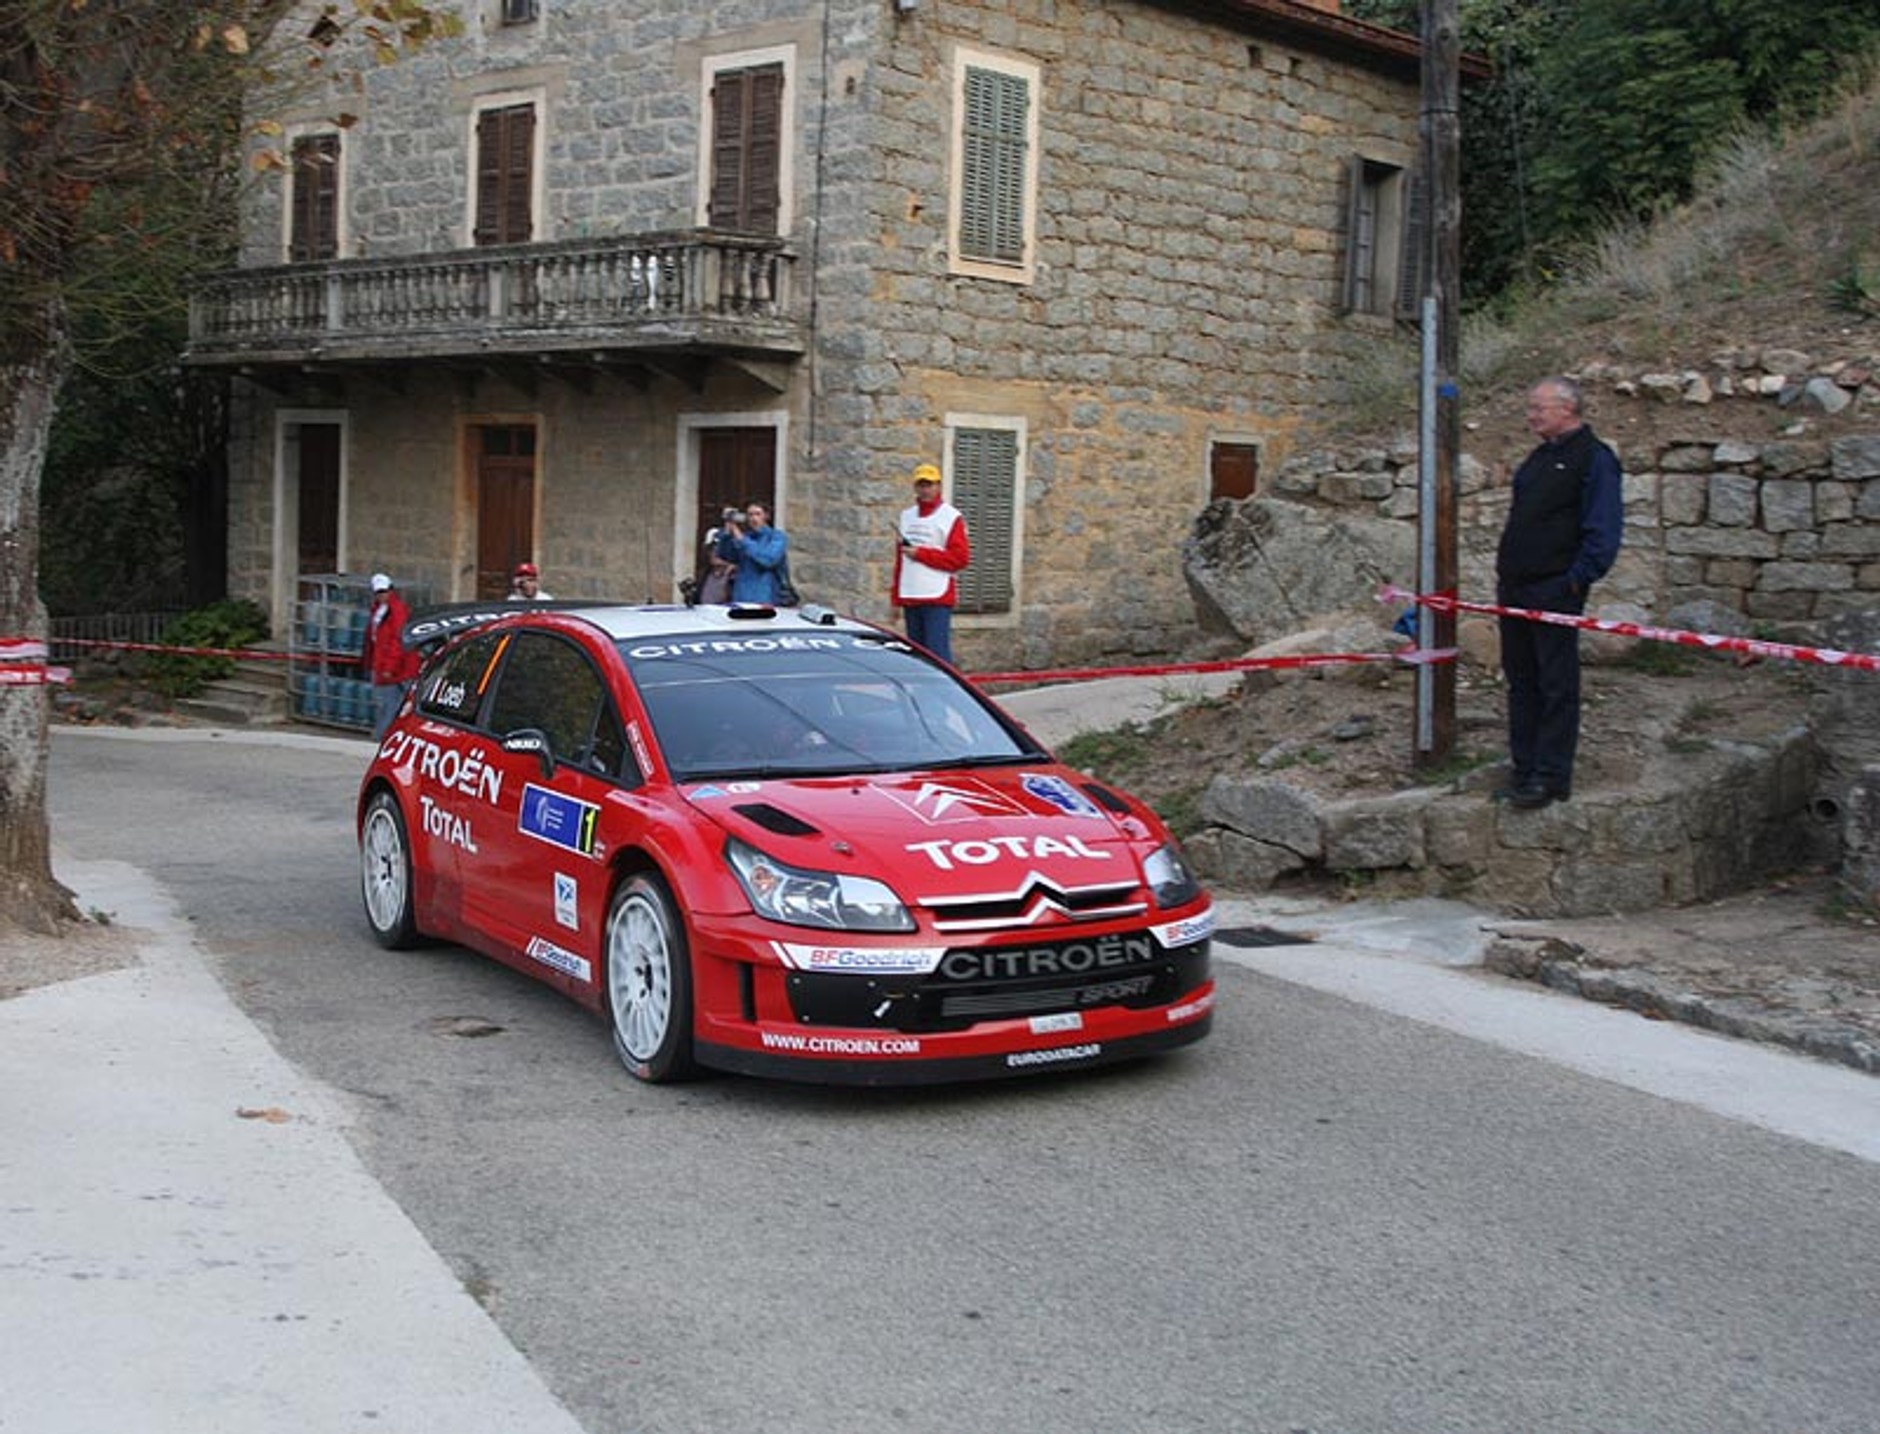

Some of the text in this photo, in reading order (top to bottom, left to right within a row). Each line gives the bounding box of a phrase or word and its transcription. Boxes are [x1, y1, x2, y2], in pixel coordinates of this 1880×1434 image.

[379, 731, 504, 804] CITROËN
[420, 795, 478, 855] TOTAL
[585, 807, 597, 853] 1
[905, 834, 1112, 870] TOTAL
[811, 949, 932, 966] BFGoodrich
[941, 934, 1152, 981] CITROËN
[761, 1031, 921, 1054] WWW.CITROEN.COM
